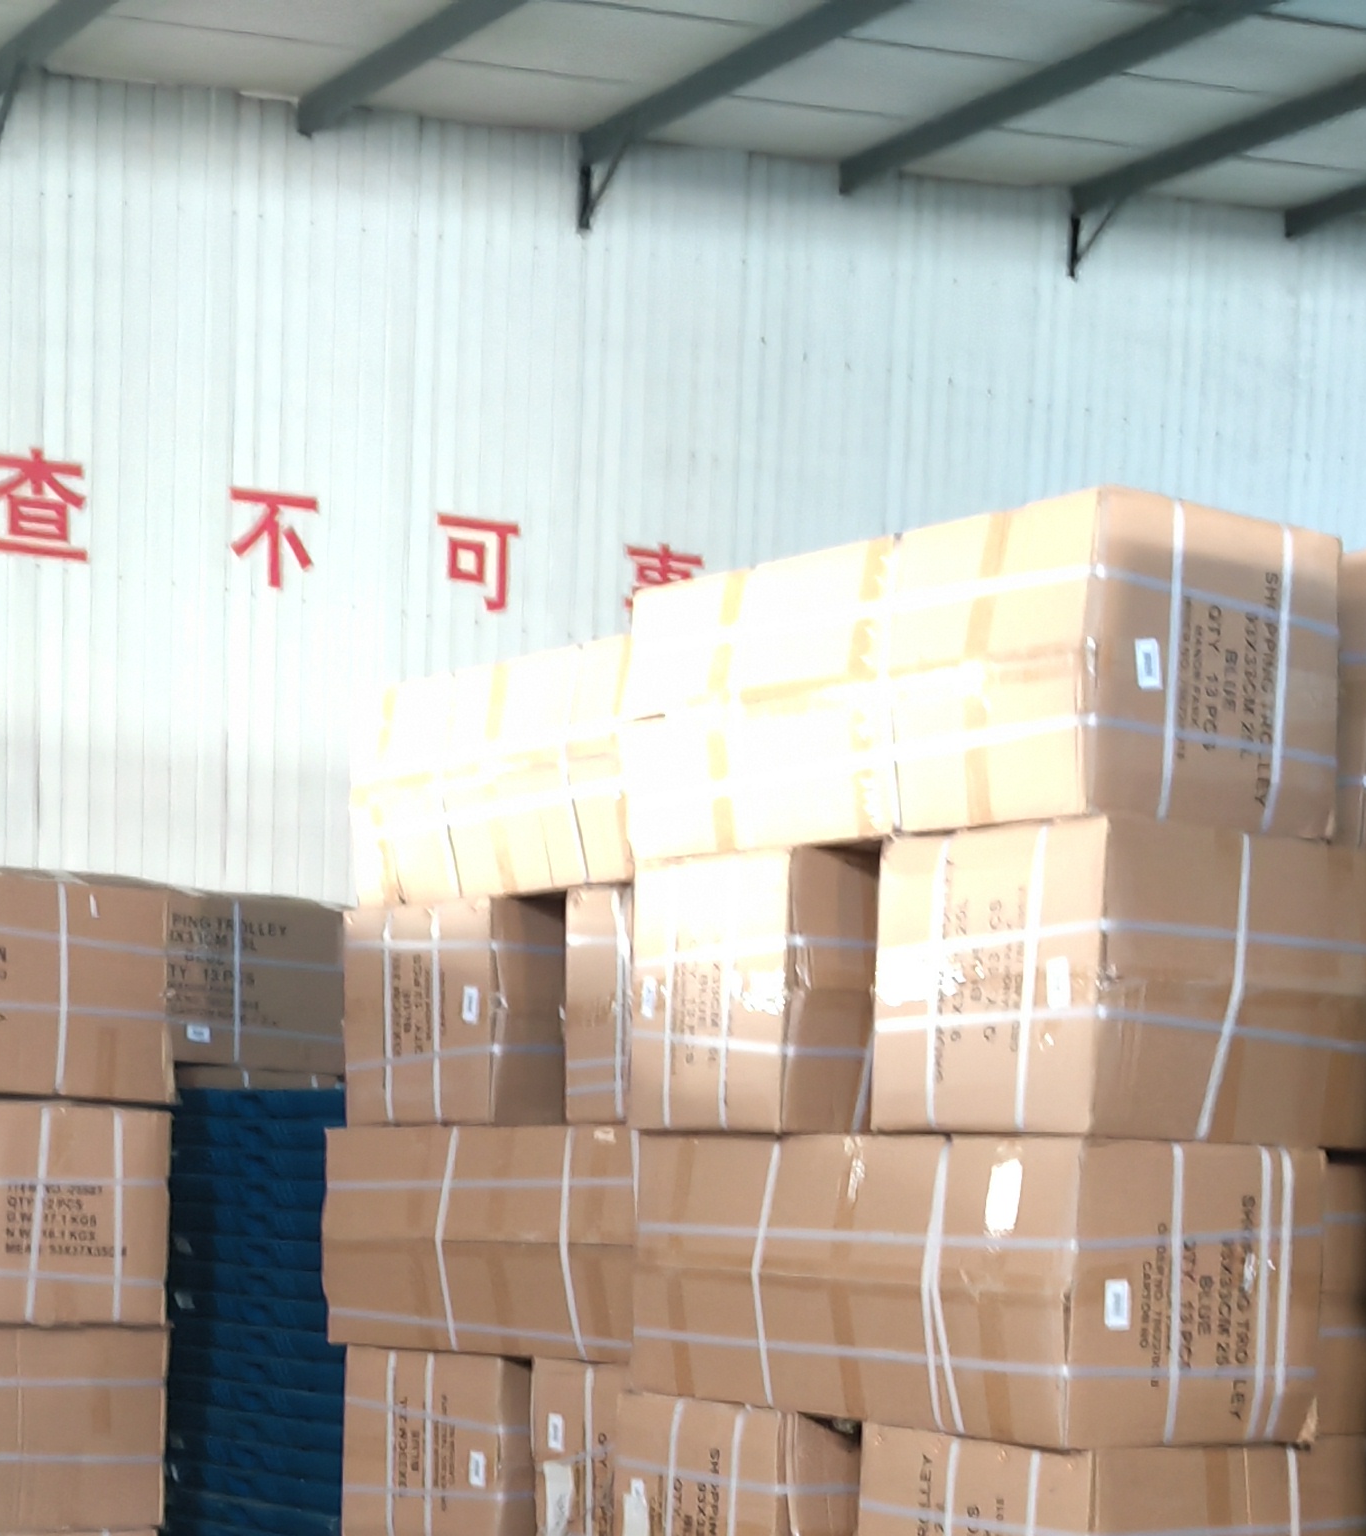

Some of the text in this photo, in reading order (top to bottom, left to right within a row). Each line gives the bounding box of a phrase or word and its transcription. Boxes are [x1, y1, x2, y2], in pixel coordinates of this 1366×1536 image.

[1223, 650, 1239, 714] BLUE
[1198, 1276, 1214, 1336] BLUE
[1230, 1318, 1249, 1421] TROLEY
